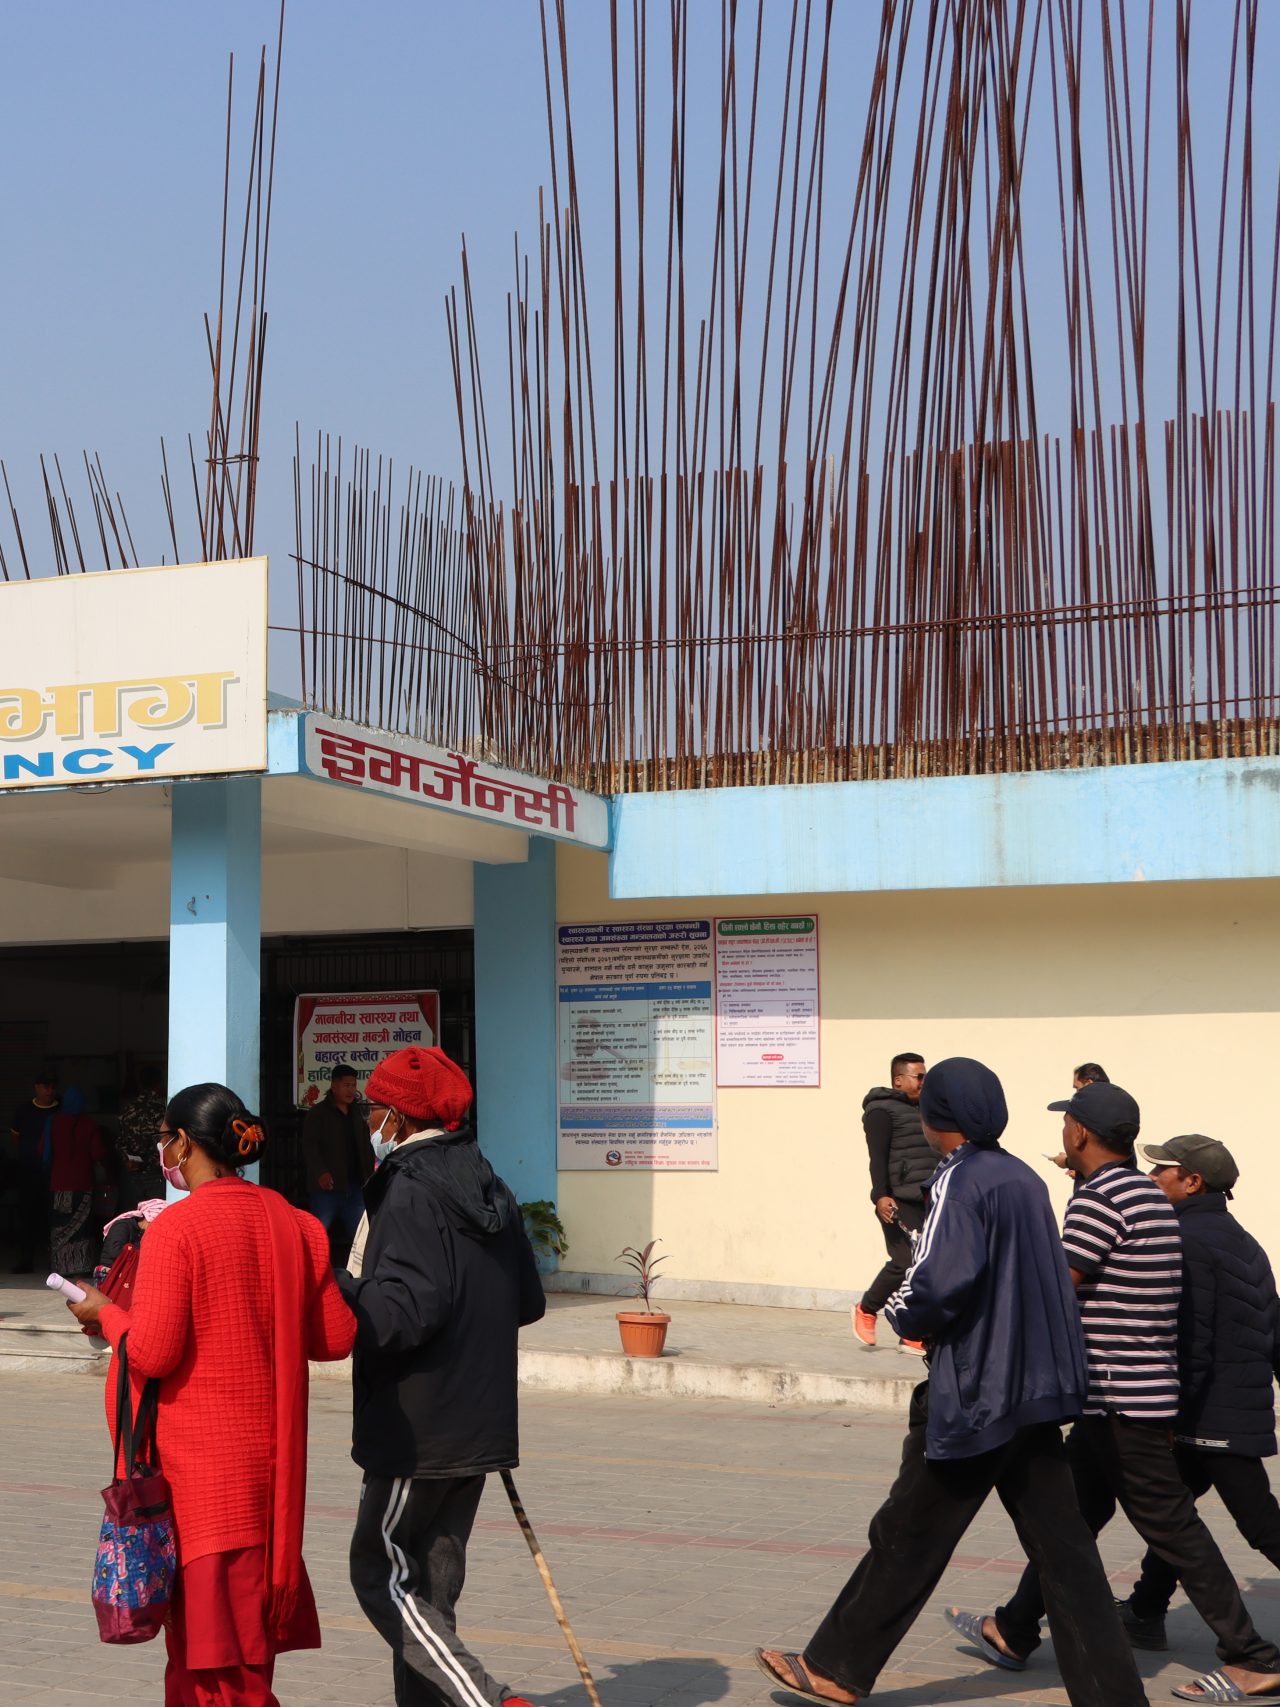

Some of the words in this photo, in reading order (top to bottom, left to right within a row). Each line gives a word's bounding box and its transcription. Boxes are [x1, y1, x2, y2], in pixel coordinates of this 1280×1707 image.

[314, 1011, 355, 1025] माननीय
[358, 1011, 397, 1025] स्वास्थ्य
[399, 1011, 420, 1022] तथा
[313, 1028, 359, 1044] जनसंख्या
[362, 1028, 390, 1044] मन्त्री
[393, 1027, 422, 1042] मोहन
[315, 1050, 347, 1065] बहादुर
[350, 1047, 379, 1063] बस्नेत
